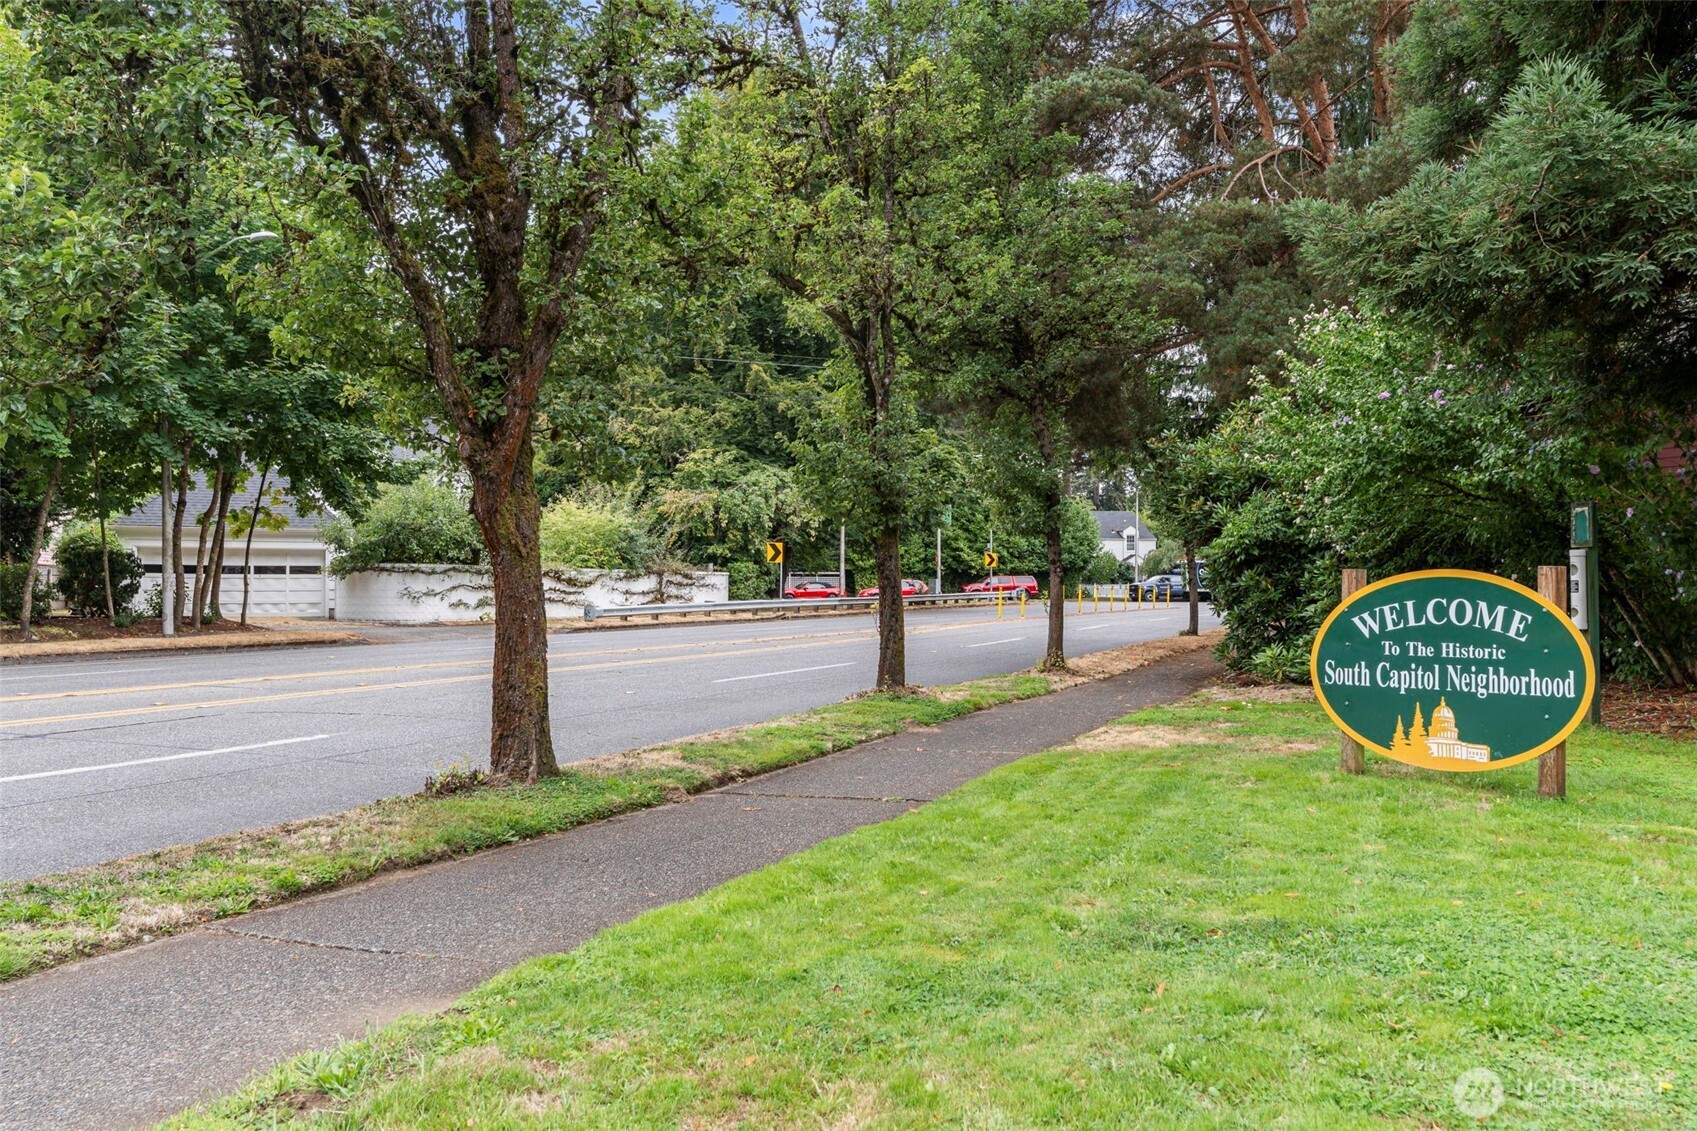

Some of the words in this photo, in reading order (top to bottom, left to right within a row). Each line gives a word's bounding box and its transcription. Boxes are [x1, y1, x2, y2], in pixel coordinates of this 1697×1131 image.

[1351, 598, 1532, 642] WELCOME
[1381, 641, 1400, 656] To
[1406, 641, 1435, 657] The
[1441, 642, 1506, 660] Historic
[1325, 659, 1371, 687] South
[1376, 661, 1440, 694] Capitol
[1446, 664, 1576, 699] Neighborhood
